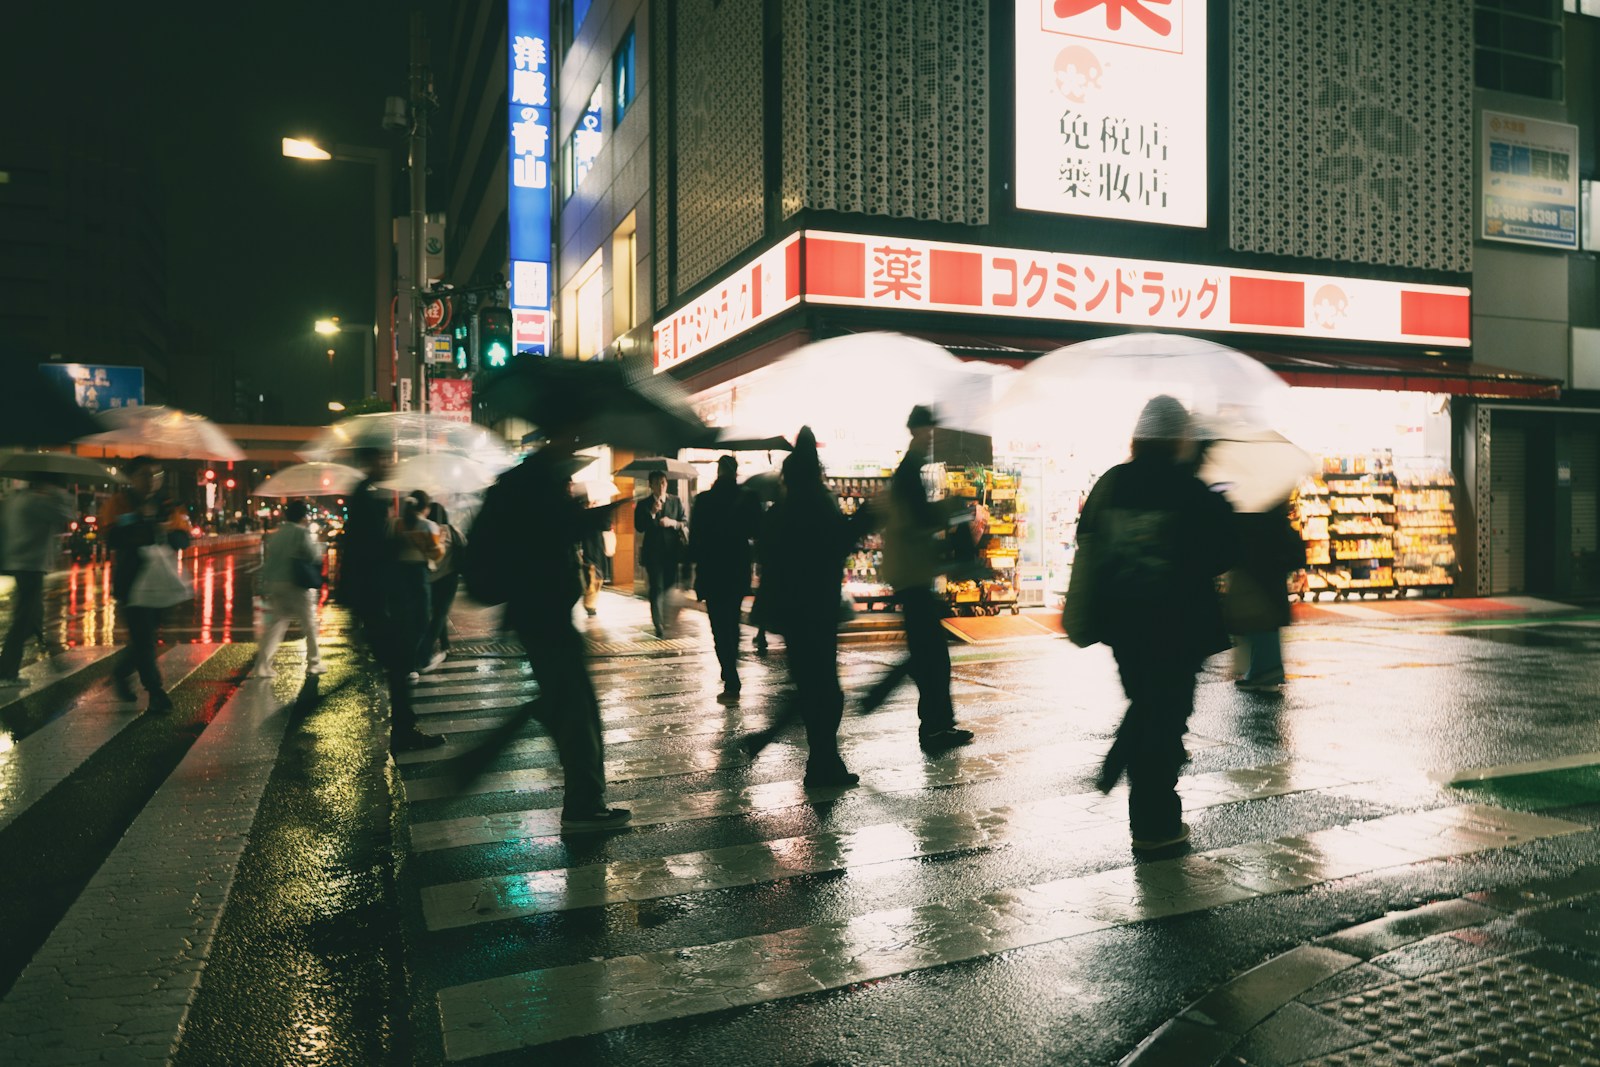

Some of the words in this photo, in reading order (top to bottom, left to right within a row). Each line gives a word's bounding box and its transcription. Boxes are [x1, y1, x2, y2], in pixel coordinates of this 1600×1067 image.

[511, 35, 549, 189] 洋服の青山
[873, 244, 923, 302] 薬
[991, 256, 1222, 320] コクミンドラッグ
